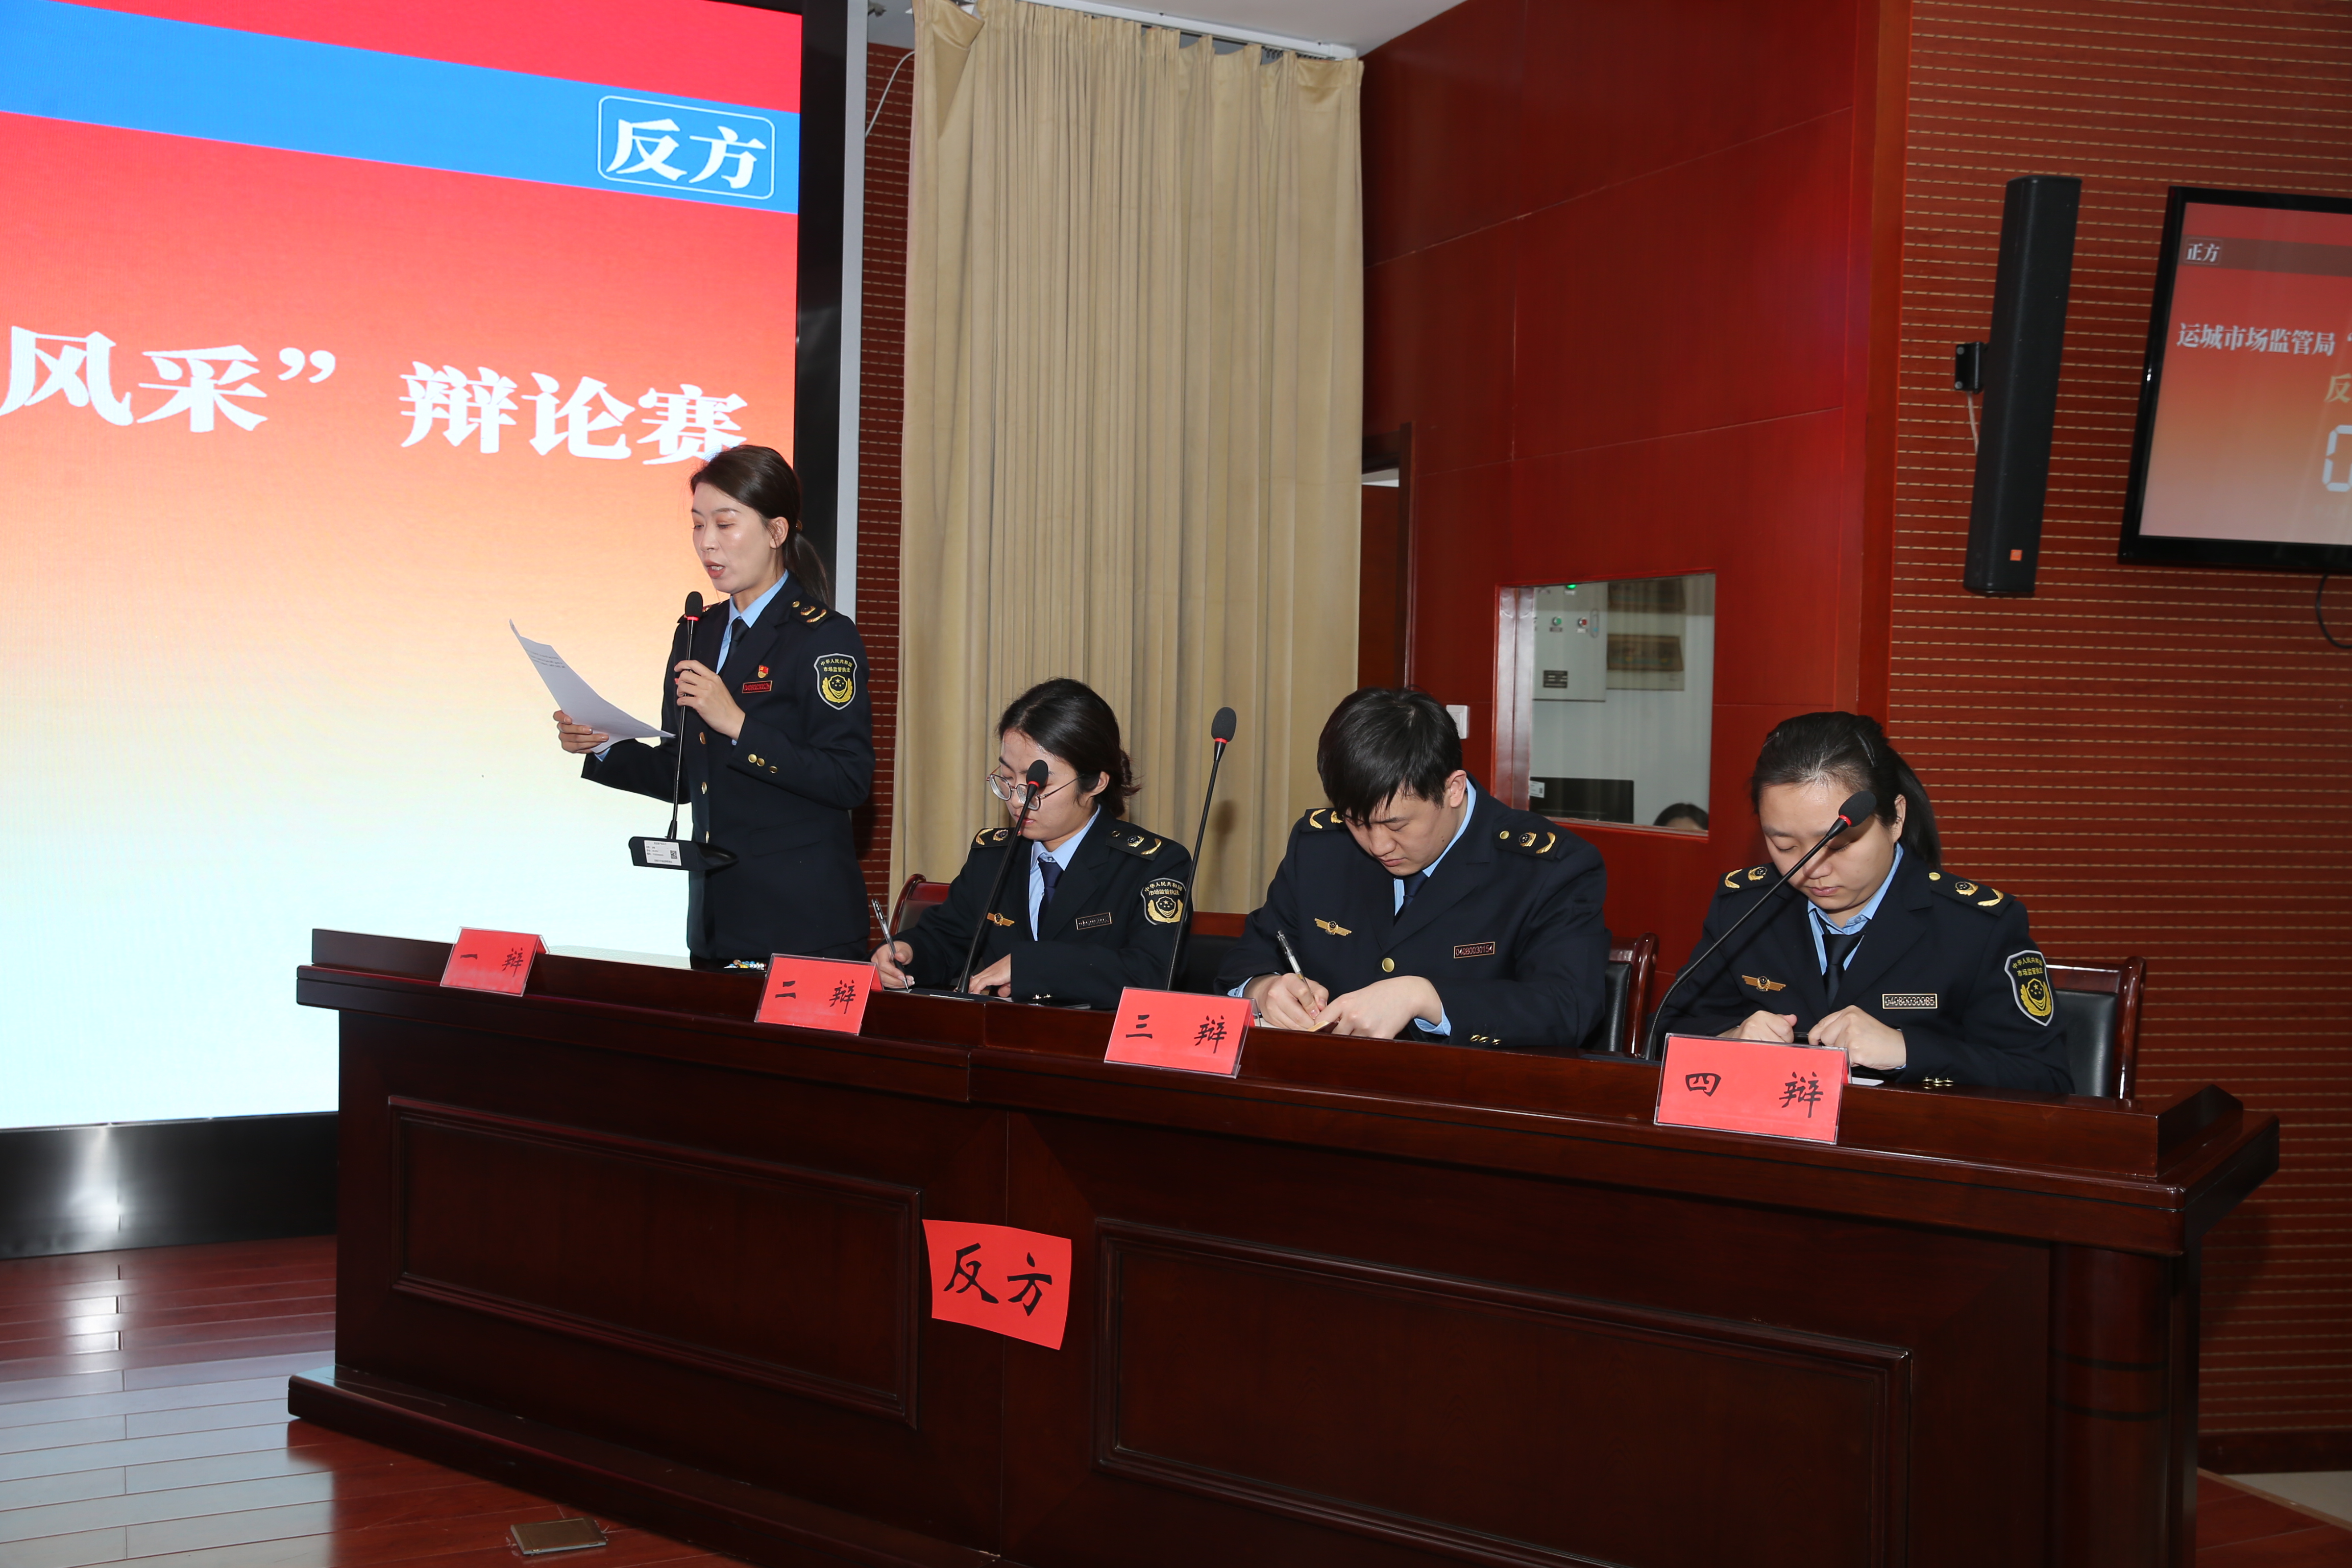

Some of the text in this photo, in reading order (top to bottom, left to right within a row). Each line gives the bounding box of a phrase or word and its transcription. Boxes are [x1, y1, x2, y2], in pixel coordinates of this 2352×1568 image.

[606, 118, 767, 189] 反方
[2186, 242, 2221, 262] 正方
[2324, 373, 2352, 403] 反
[820, 658, 853, 668] 中华人民共和国
[1144, 881, 1183, 892] 中华人民共和国
[943, 1242, 1052, 1317] 反方
